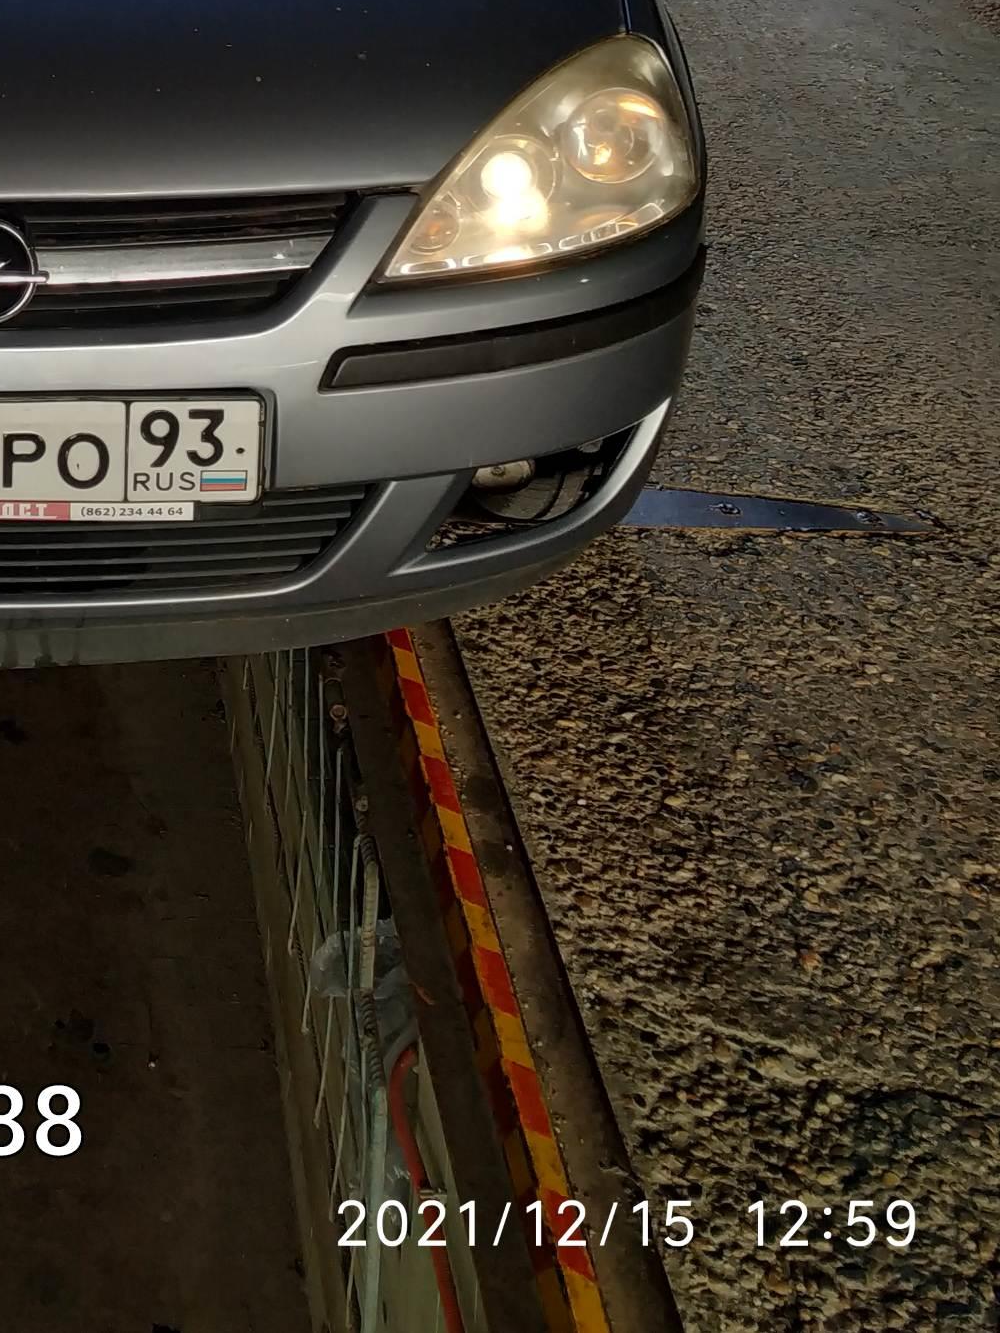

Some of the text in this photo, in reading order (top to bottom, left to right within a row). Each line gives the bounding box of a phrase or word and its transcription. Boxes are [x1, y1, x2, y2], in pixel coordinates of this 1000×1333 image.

[140, 409, 225, 468] 93
[133, 471, 196, 492] RUS
[80, 505, 116, 517] (862)
[118, 506, 143, 517] 234
[146, 506, 163, 517] 44
[167, 506, 184, 517] 64
